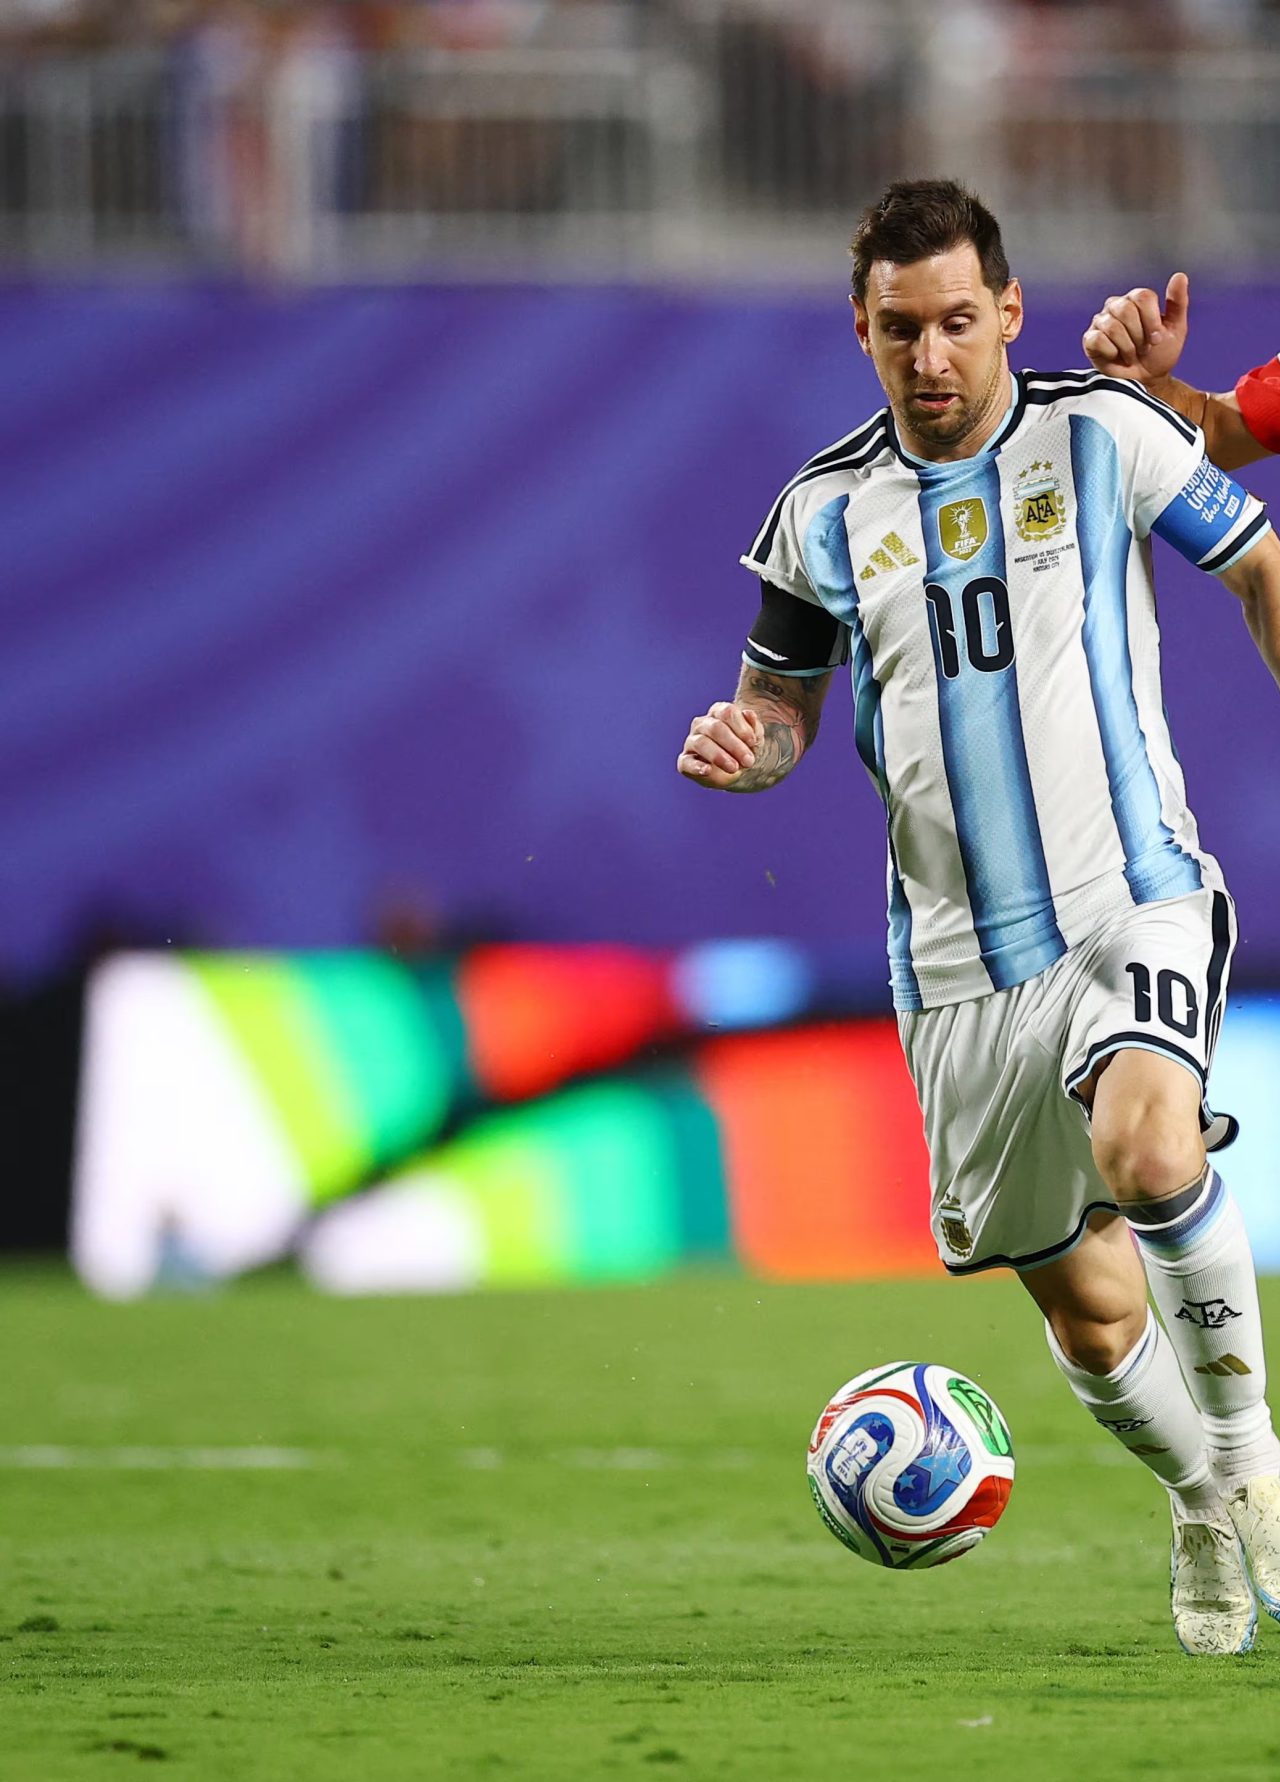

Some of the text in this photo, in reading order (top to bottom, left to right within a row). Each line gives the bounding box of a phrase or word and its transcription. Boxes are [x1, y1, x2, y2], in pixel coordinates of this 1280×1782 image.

[1025, 493, 1056, 523] AFA
[1200, 502, 1220, 524] the
[954, 536, 977, 549] FIFA
[924, 575, 1015, 680] 10
[1125, 961, 1199, 1039] 10
[1174, 1298, 1242, 1329] AFA
